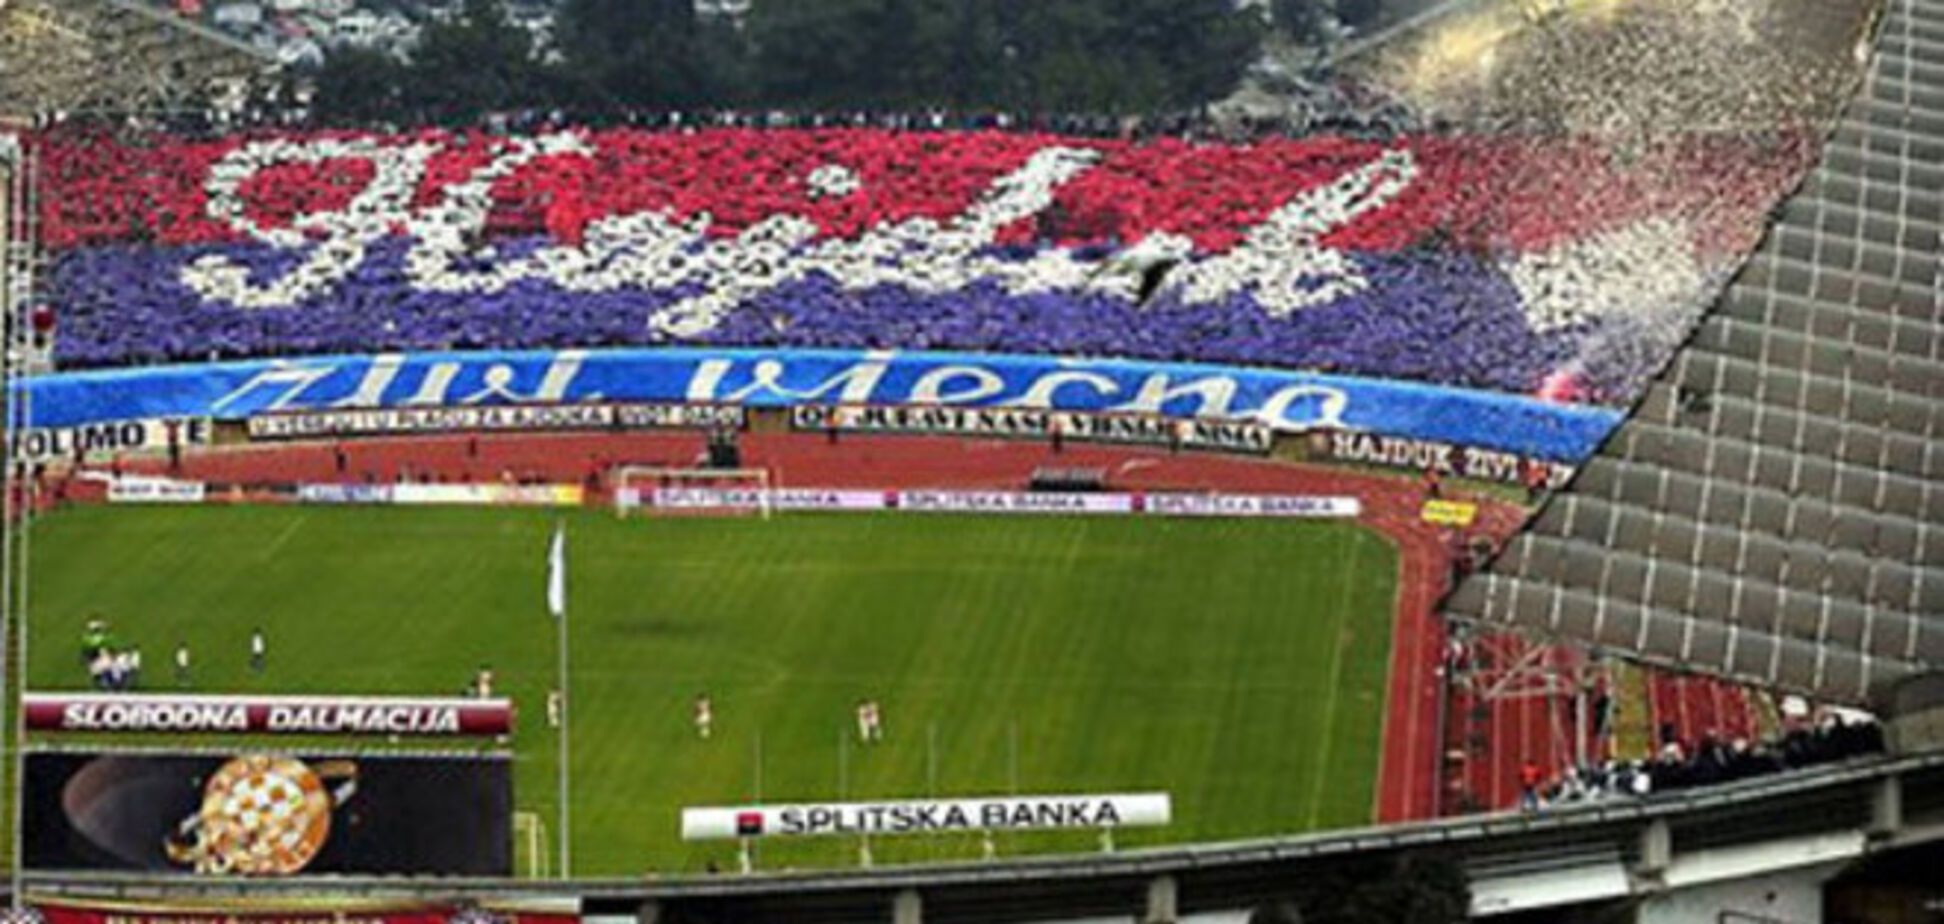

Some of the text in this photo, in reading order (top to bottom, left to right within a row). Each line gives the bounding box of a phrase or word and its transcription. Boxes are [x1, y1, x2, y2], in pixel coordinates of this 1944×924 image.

[1333, 432, 1454, 472] HAJDUK
[906, 493, 1087, 510] SPLITSKA BANKA
[1259, 496, 1335, 512] BANKA
[62, 702, 461, 732] SLOBODNA DALMACIJA
[780, 800, 1122, 835] SPLITSKA BANKA
